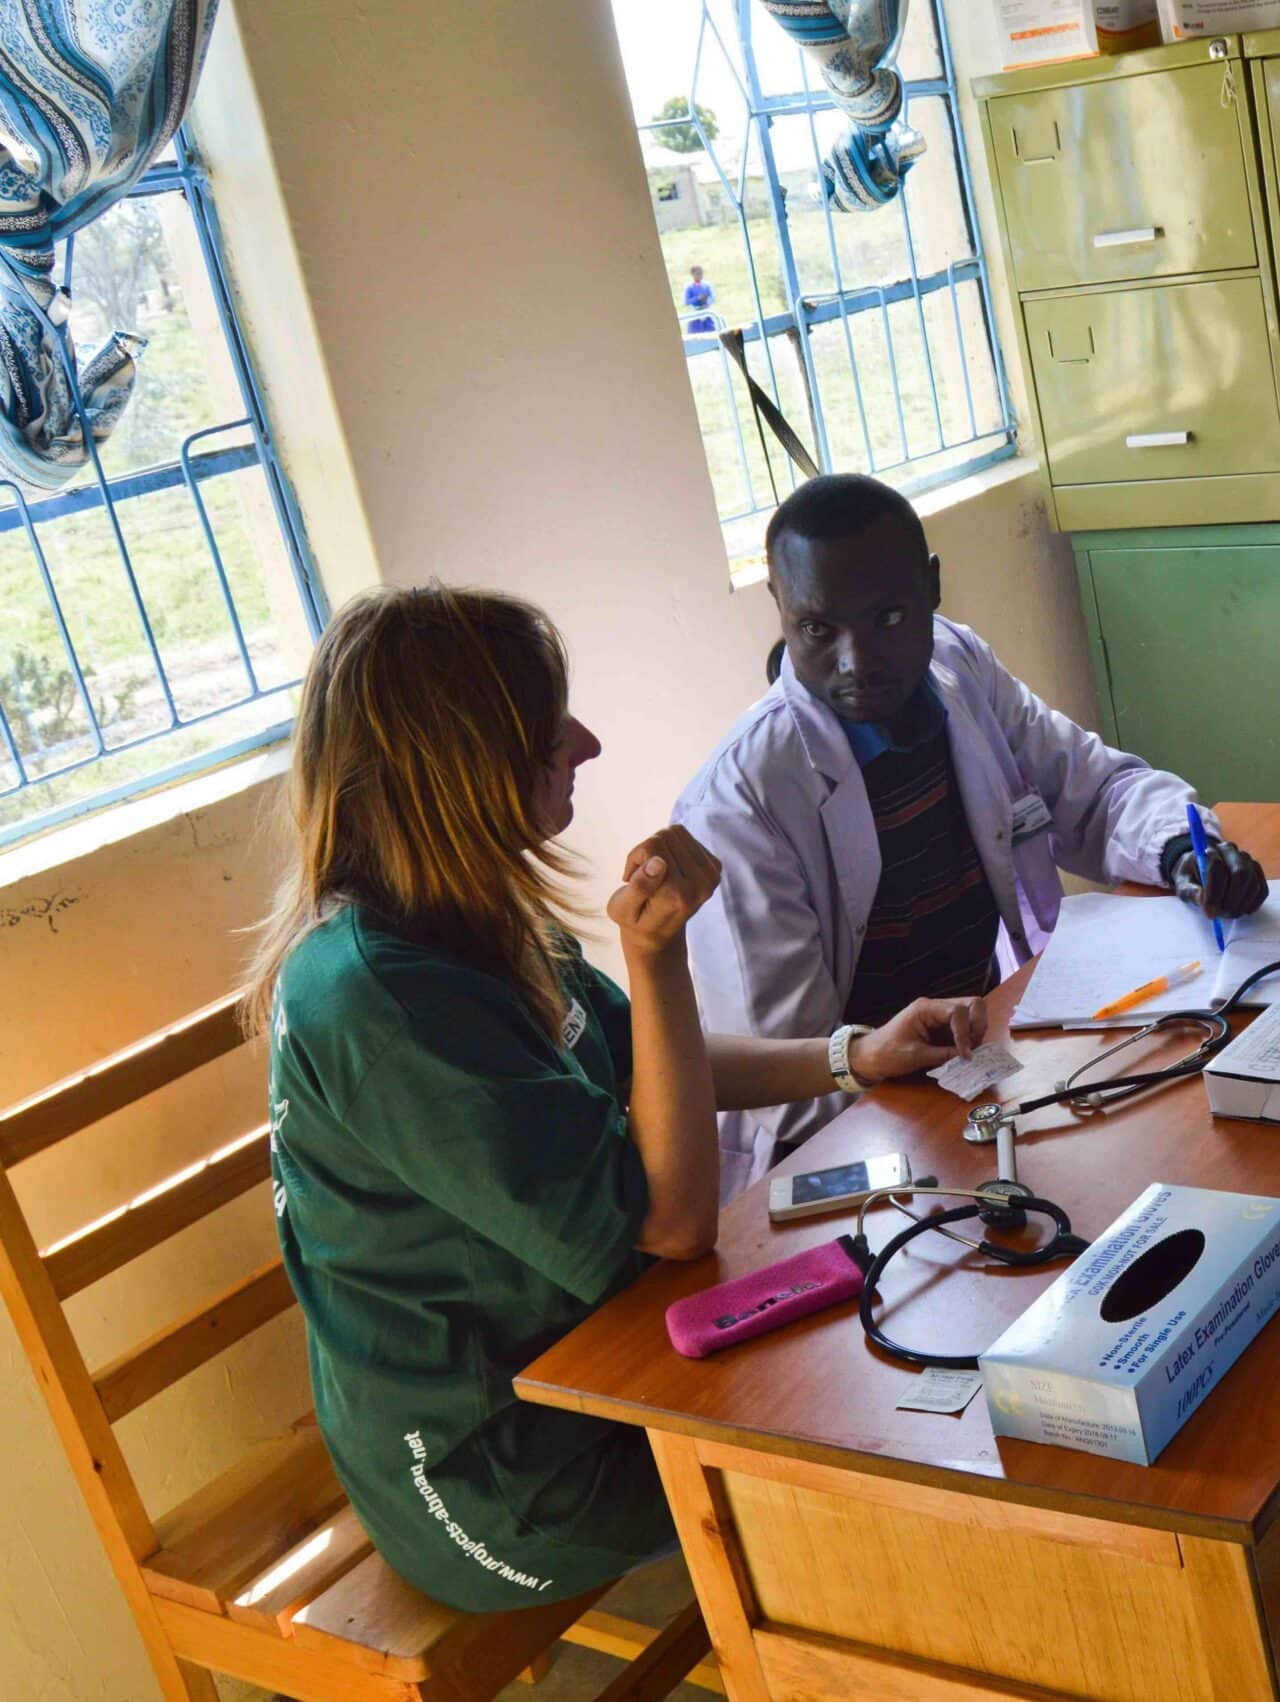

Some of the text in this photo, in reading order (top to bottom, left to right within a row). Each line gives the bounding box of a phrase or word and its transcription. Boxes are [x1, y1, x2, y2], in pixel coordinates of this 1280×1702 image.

[1078, 1225, 1141, 1286] Examination
[1102, 1317, 1147, 1361] Non-Sterile
[1117, 1333, 1150, 1364] Smooth
[1131, 1310, 1187, 1368] For Single Use
[1165, 1343, 1196, 1384] Latex
[1194, 1274, 1255, 1349] Examination
